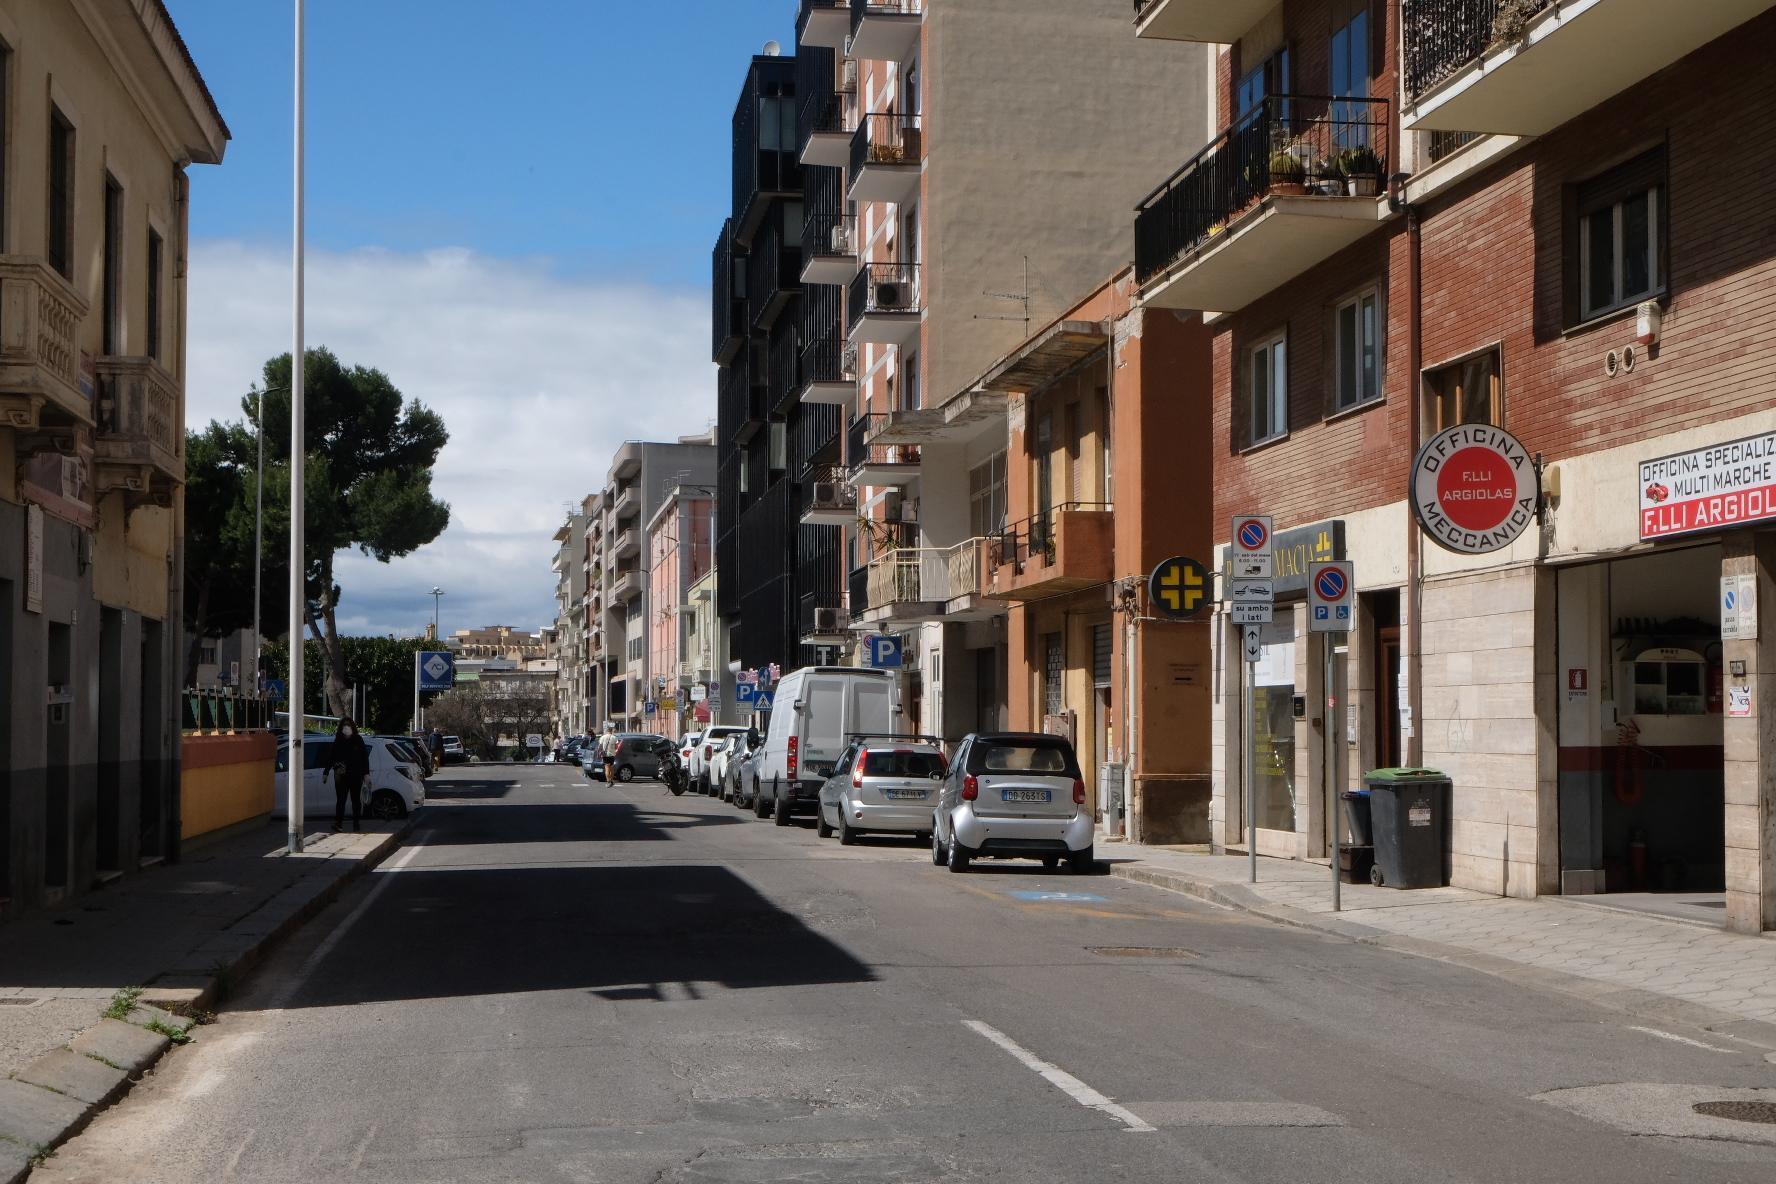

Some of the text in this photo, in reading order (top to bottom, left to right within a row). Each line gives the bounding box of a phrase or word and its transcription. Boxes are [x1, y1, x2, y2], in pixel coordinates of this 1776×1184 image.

[1424, 429, 1524, 473] OFFICINA
[1643, 437, 1776, 482] OFFICINA SPECIALIZ
[1462, 470, 1492, 482] F.LLI
[1674, 462, 1771, 498] MULTI MARCHE
[1443, 488, 1513, 501] ARGIOLAS
[1424, 497, 1533, 549] MECCANICA
[1644, 504, 1687, 534] F.LLI
[1317, 608, 1325, 618] P
[817, 646, 831, 666] T
[877, 641, 895, 662] P
[740, 685, 751, 699] P
